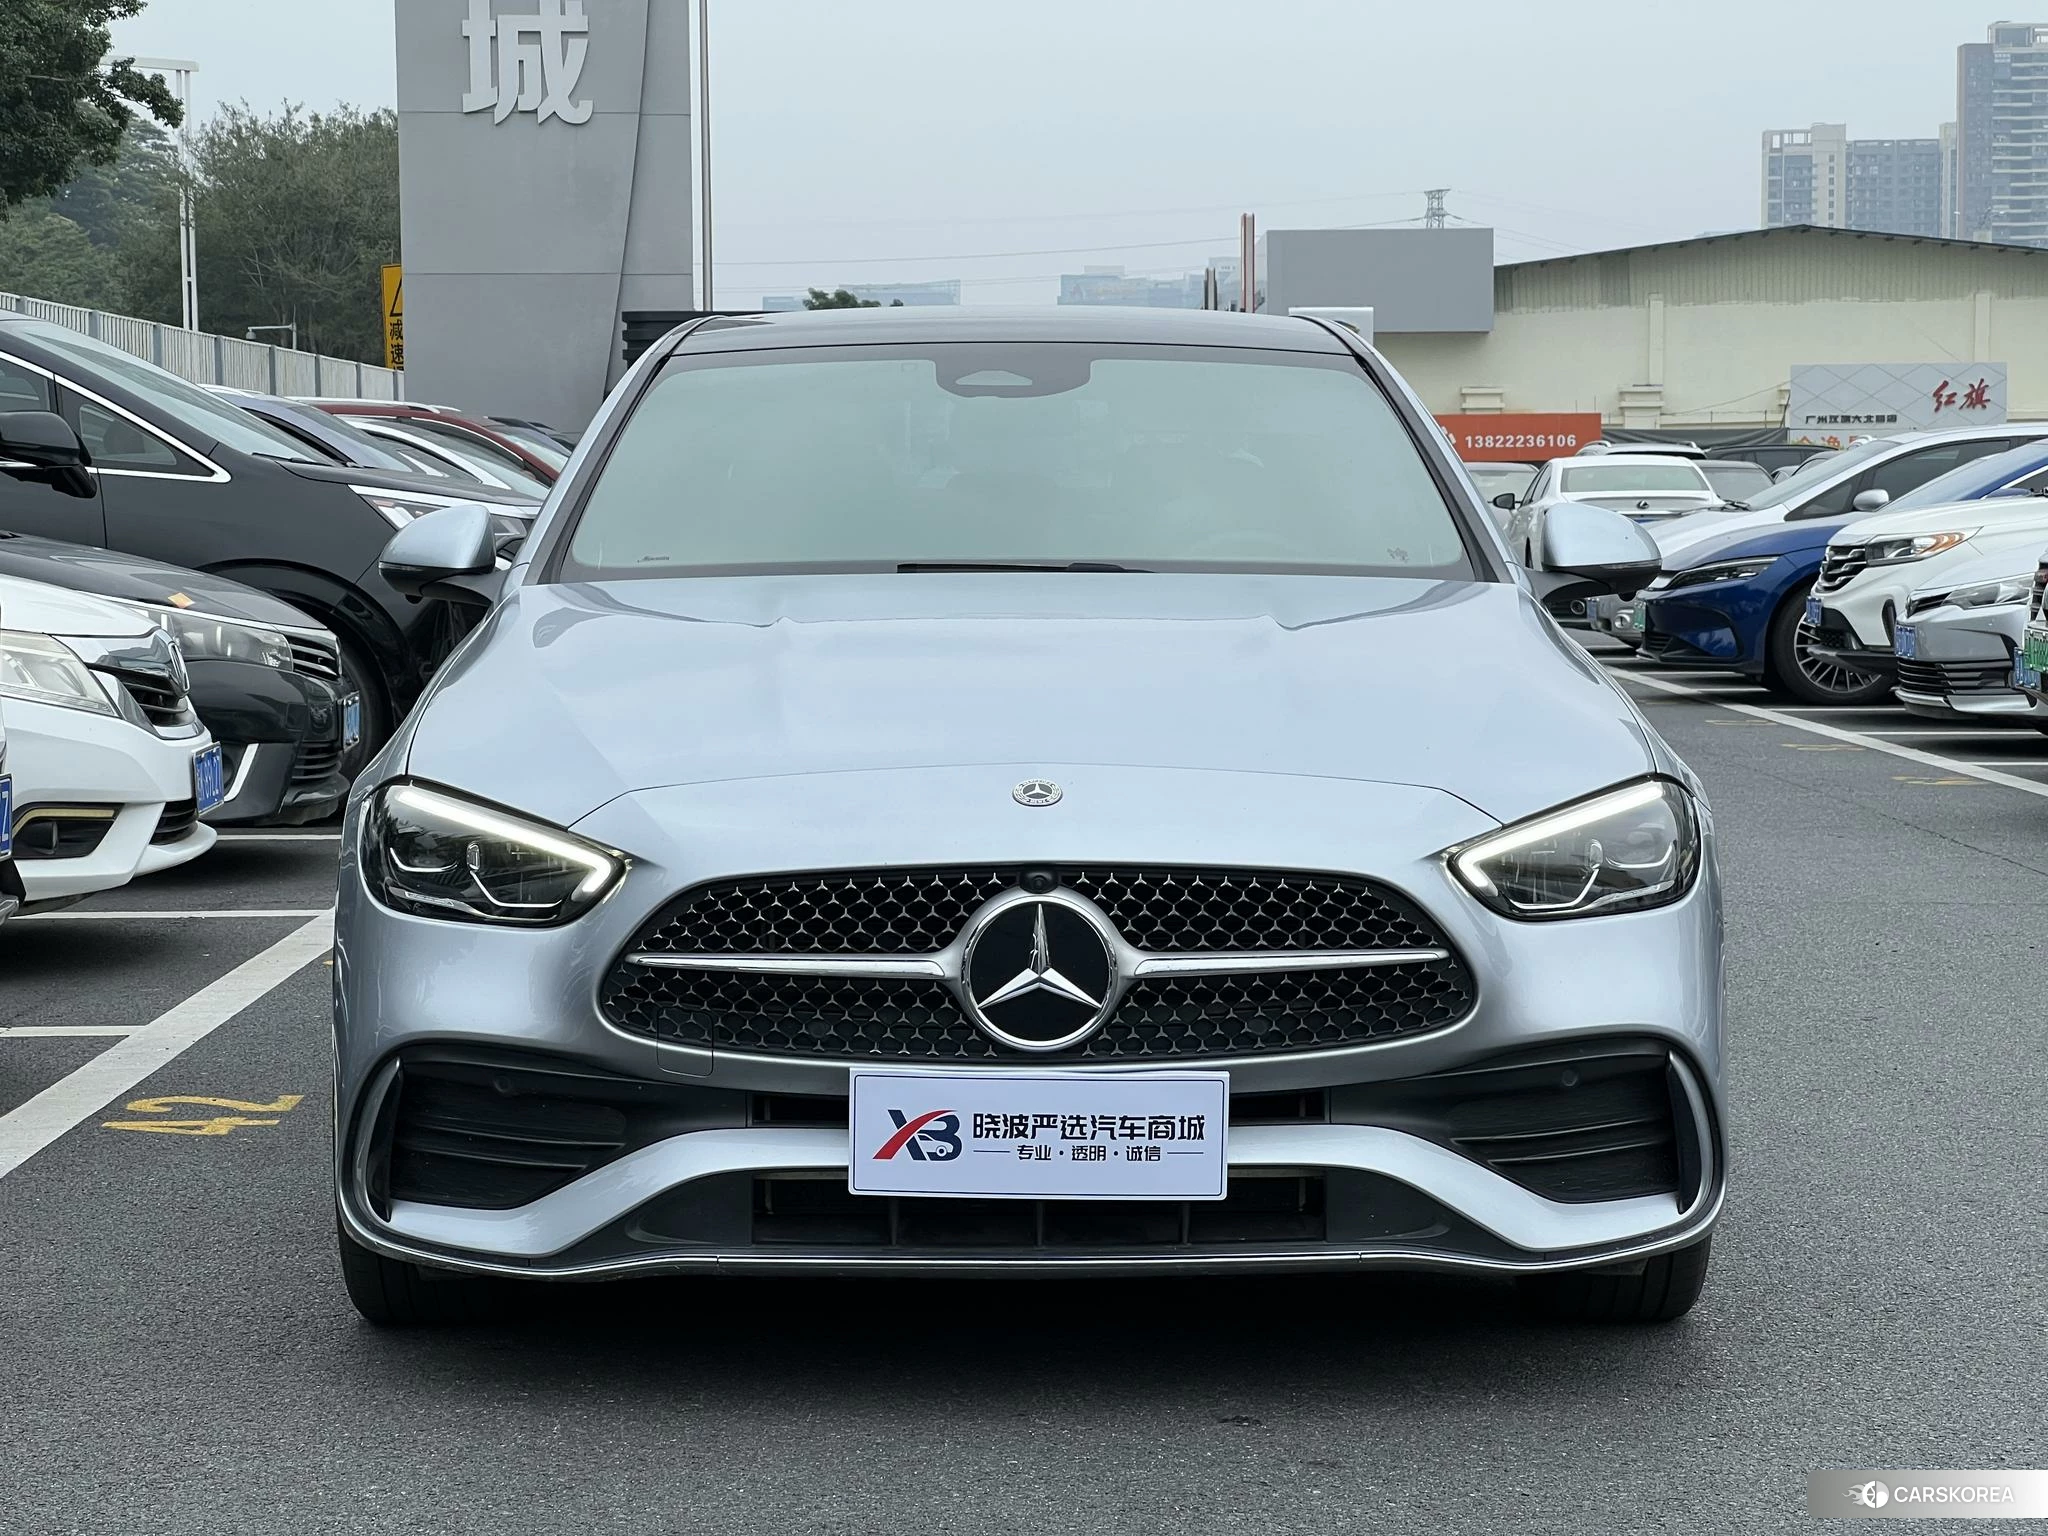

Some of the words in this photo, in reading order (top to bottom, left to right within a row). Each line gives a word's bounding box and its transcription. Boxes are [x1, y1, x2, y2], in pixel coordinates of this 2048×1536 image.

[462, 0, 594, 125] 城
[389, 319, 404, 371] 减速
[1933, 378, 1991, 413] 红旗
[1465, 434, 1577, 448] 13822236106
[972, 1113, 1205, 1141] 晓波严选汽车商城
